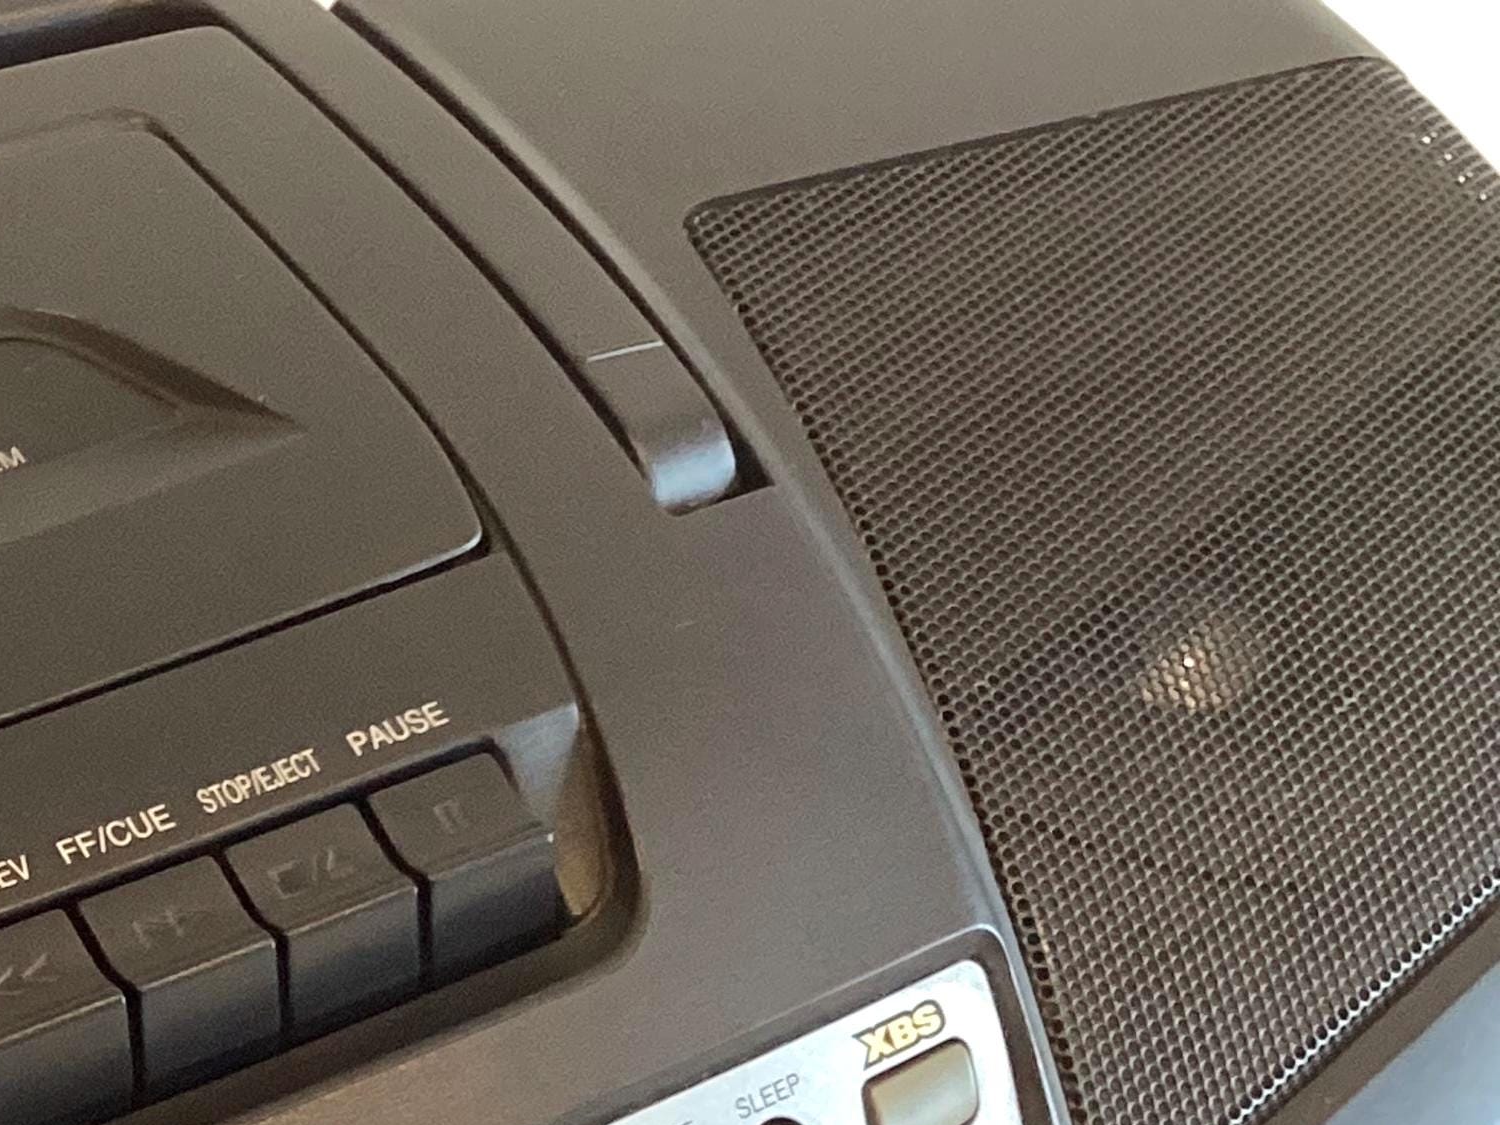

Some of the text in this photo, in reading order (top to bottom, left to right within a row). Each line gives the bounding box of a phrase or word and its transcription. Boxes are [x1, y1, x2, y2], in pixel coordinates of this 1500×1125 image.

[346, 701, 450, 757] PAUSE
[196, 748, 321, 814] STOP/EJECT
[56, 804, 177, 865] FF/CUE
[852, 999, 946, 1071] XBS
[734, 1072, 800, 1120] SLEEP
